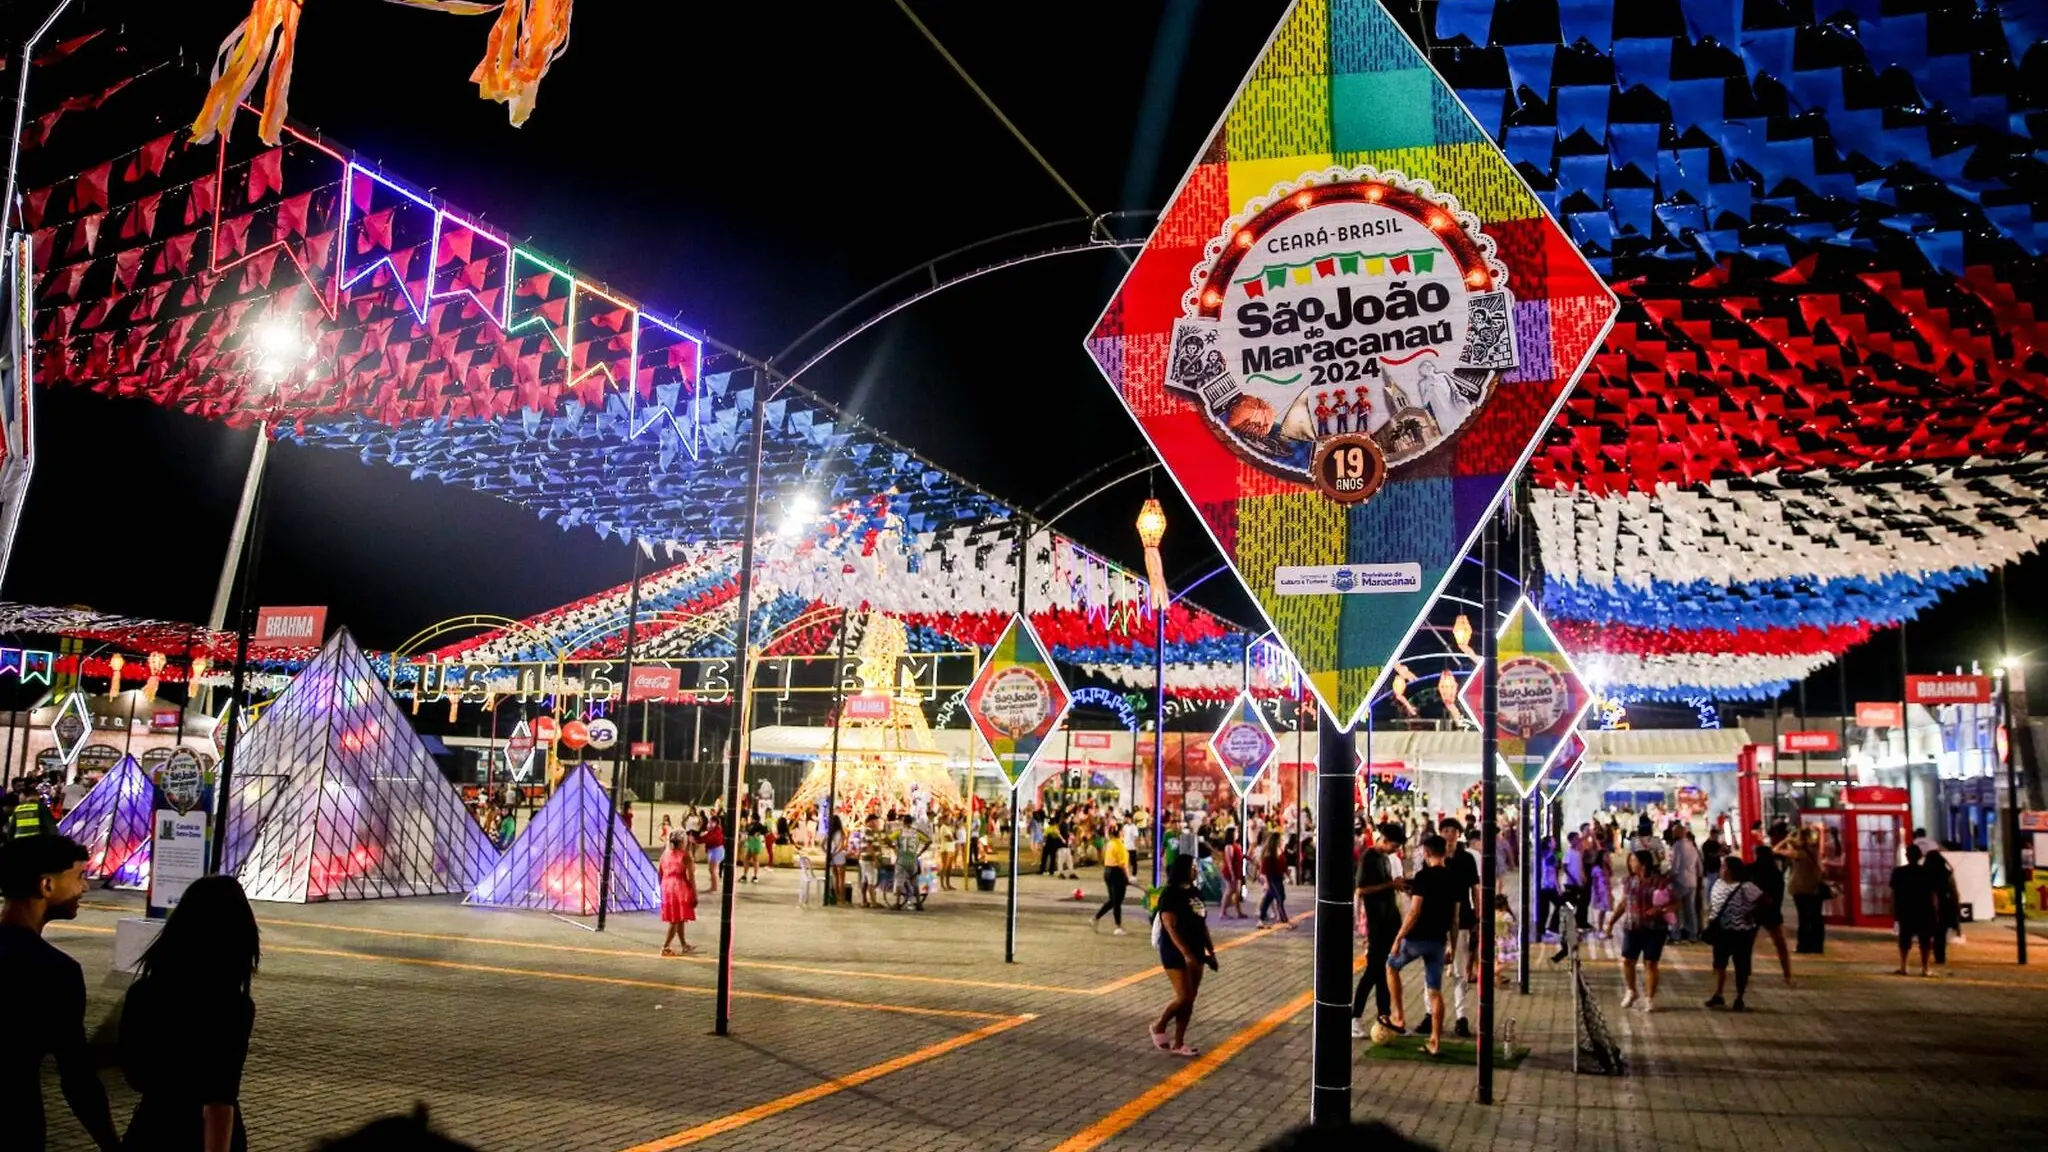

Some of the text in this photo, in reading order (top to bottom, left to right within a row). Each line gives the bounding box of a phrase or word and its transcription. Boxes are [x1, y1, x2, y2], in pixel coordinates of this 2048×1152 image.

[1268, 218, 1402, 253] CEARÁ-BRASIL
[1238, 281, 1450, 338] São João
[1304, 325, 1324, 340] de
[1242, 319, 1453, 375] Maracanaú
[1310, 357, 1381, 386] 2024
[1333, 447, 1364, 478] 19
[1336, 478, 1364, 491] ANOS
[1361, 576, 1416, 586] Maracanaú
[265, 615, 314, 637] BRAHMA
[635, 675, 672, 689] Coca-Cola
[1917, 681, 1979, 698] BRAHMA
[590, 729, 612, 741] 93
